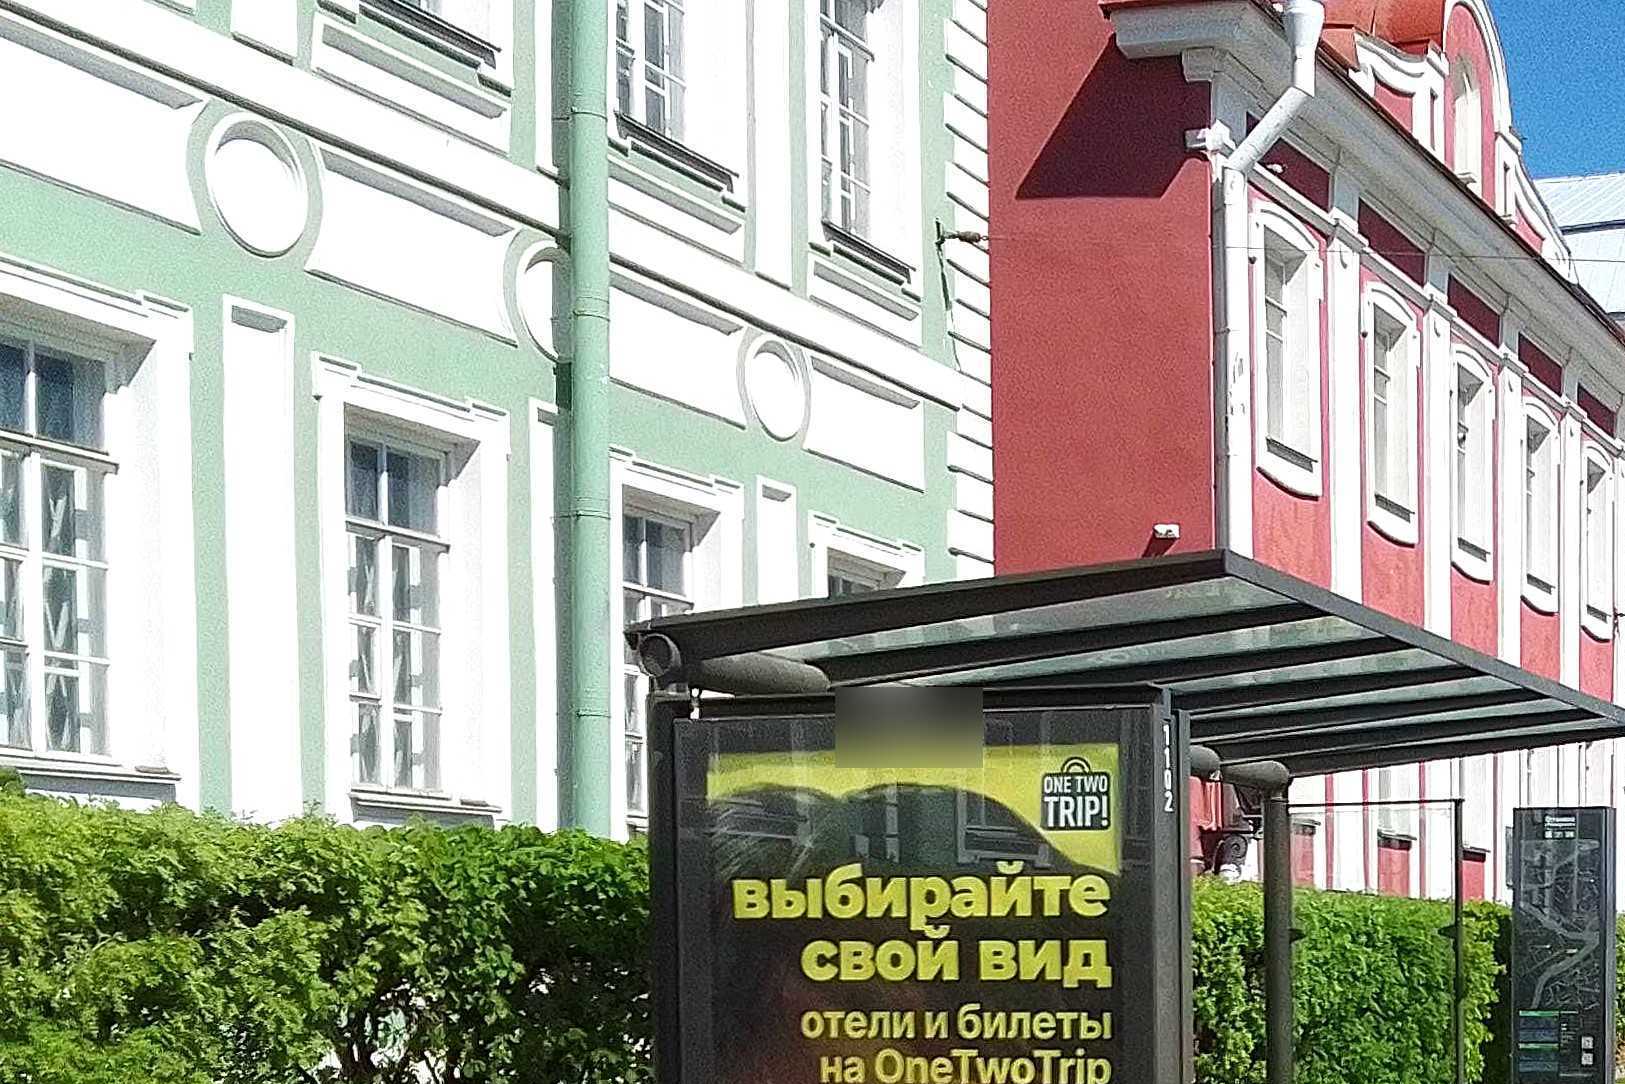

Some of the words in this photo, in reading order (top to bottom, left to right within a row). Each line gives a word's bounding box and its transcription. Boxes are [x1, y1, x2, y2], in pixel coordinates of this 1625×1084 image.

[1043, 775, 1072, 793] ONE
[1075, 774, 1108, 793] TWO
[1163, 724, 1174, 812] 1102
[1043, 795, 1108, 827] TRIP!
[731, 860, 1112, 932] выбирайте
[800, 925, 960, 982] свой
[978, 938, 1113, 989] вид
[800, 1007, 916, 1040] отели
[924, 1010, 949, 1040] и
[956, 1002, 1113, 1040] билеты
